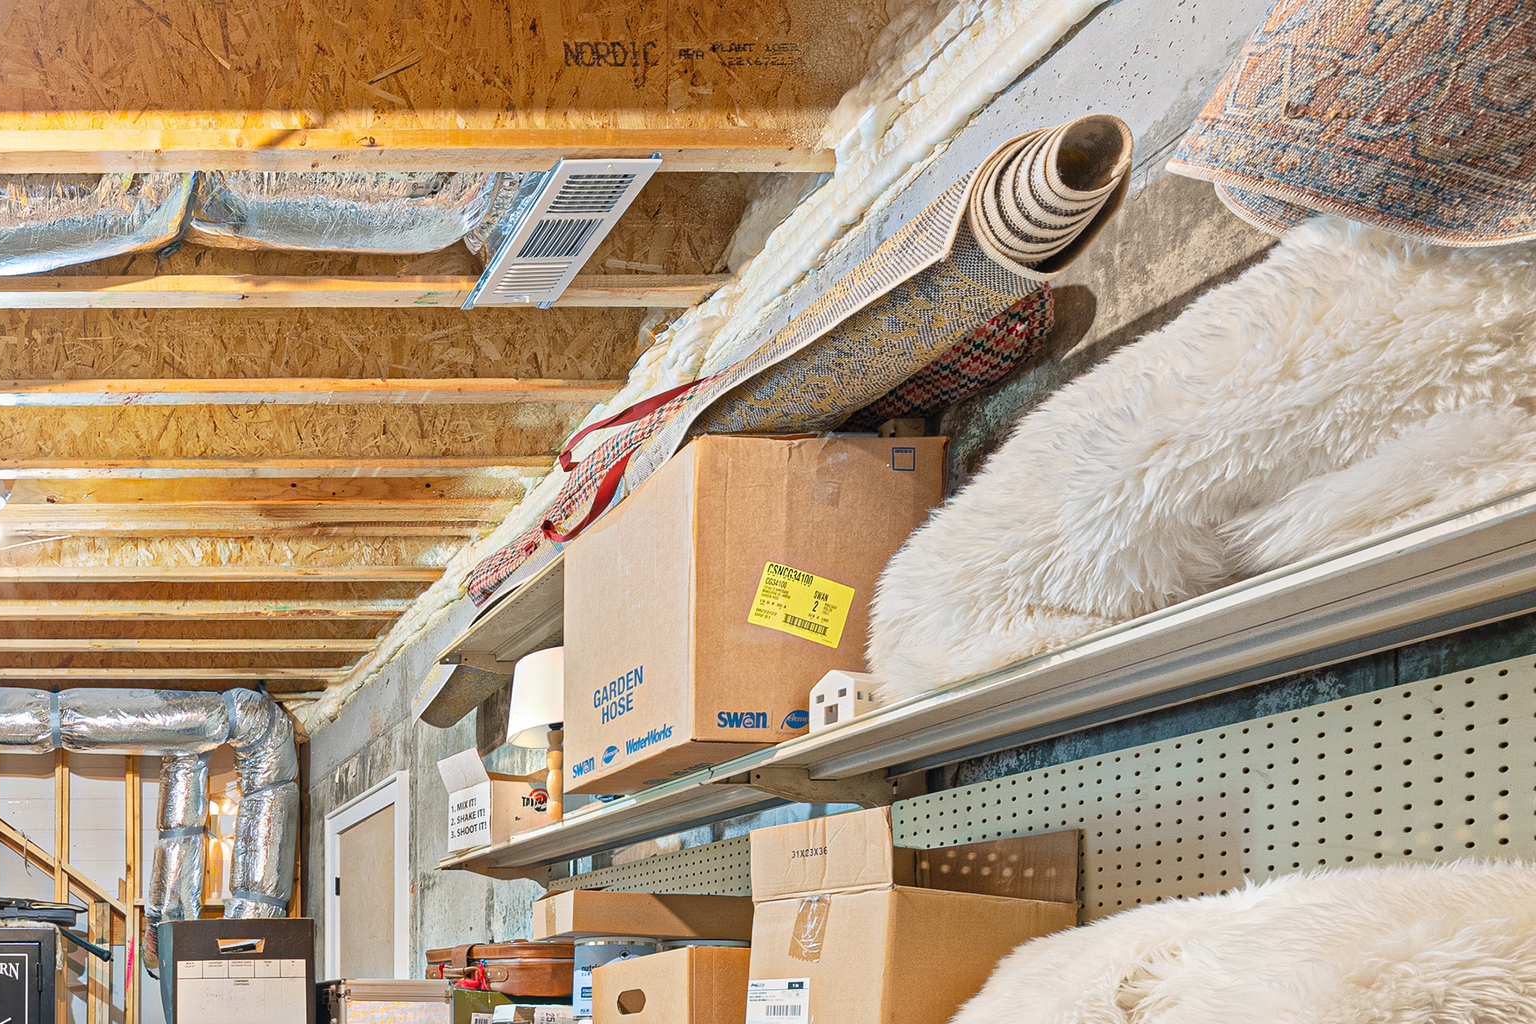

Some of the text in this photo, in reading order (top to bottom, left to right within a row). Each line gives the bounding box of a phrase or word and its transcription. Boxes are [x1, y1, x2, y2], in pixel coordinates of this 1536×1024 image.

[563, 39, 659, 67] NORDIC
[814, 590, 829, 602] SWAN
[812, 600, 819, 612] 2
[593, 665, 644, 709] GARDEN
[602, 692, 634, 725] HOSE
[718, 711, 767, 729] swan
[572, 756, 595, 779] swan
[626, 724, 674, 756] WaterWorks
[457, 801, 468, 810] MIX
[457, 811, 476, 824] SHAKE
[477, 808, 485, 818] IT!
[451, 821, 487, 839] 3. SHOOT IT!
[792, 846, 828, 858] 31X23X36
